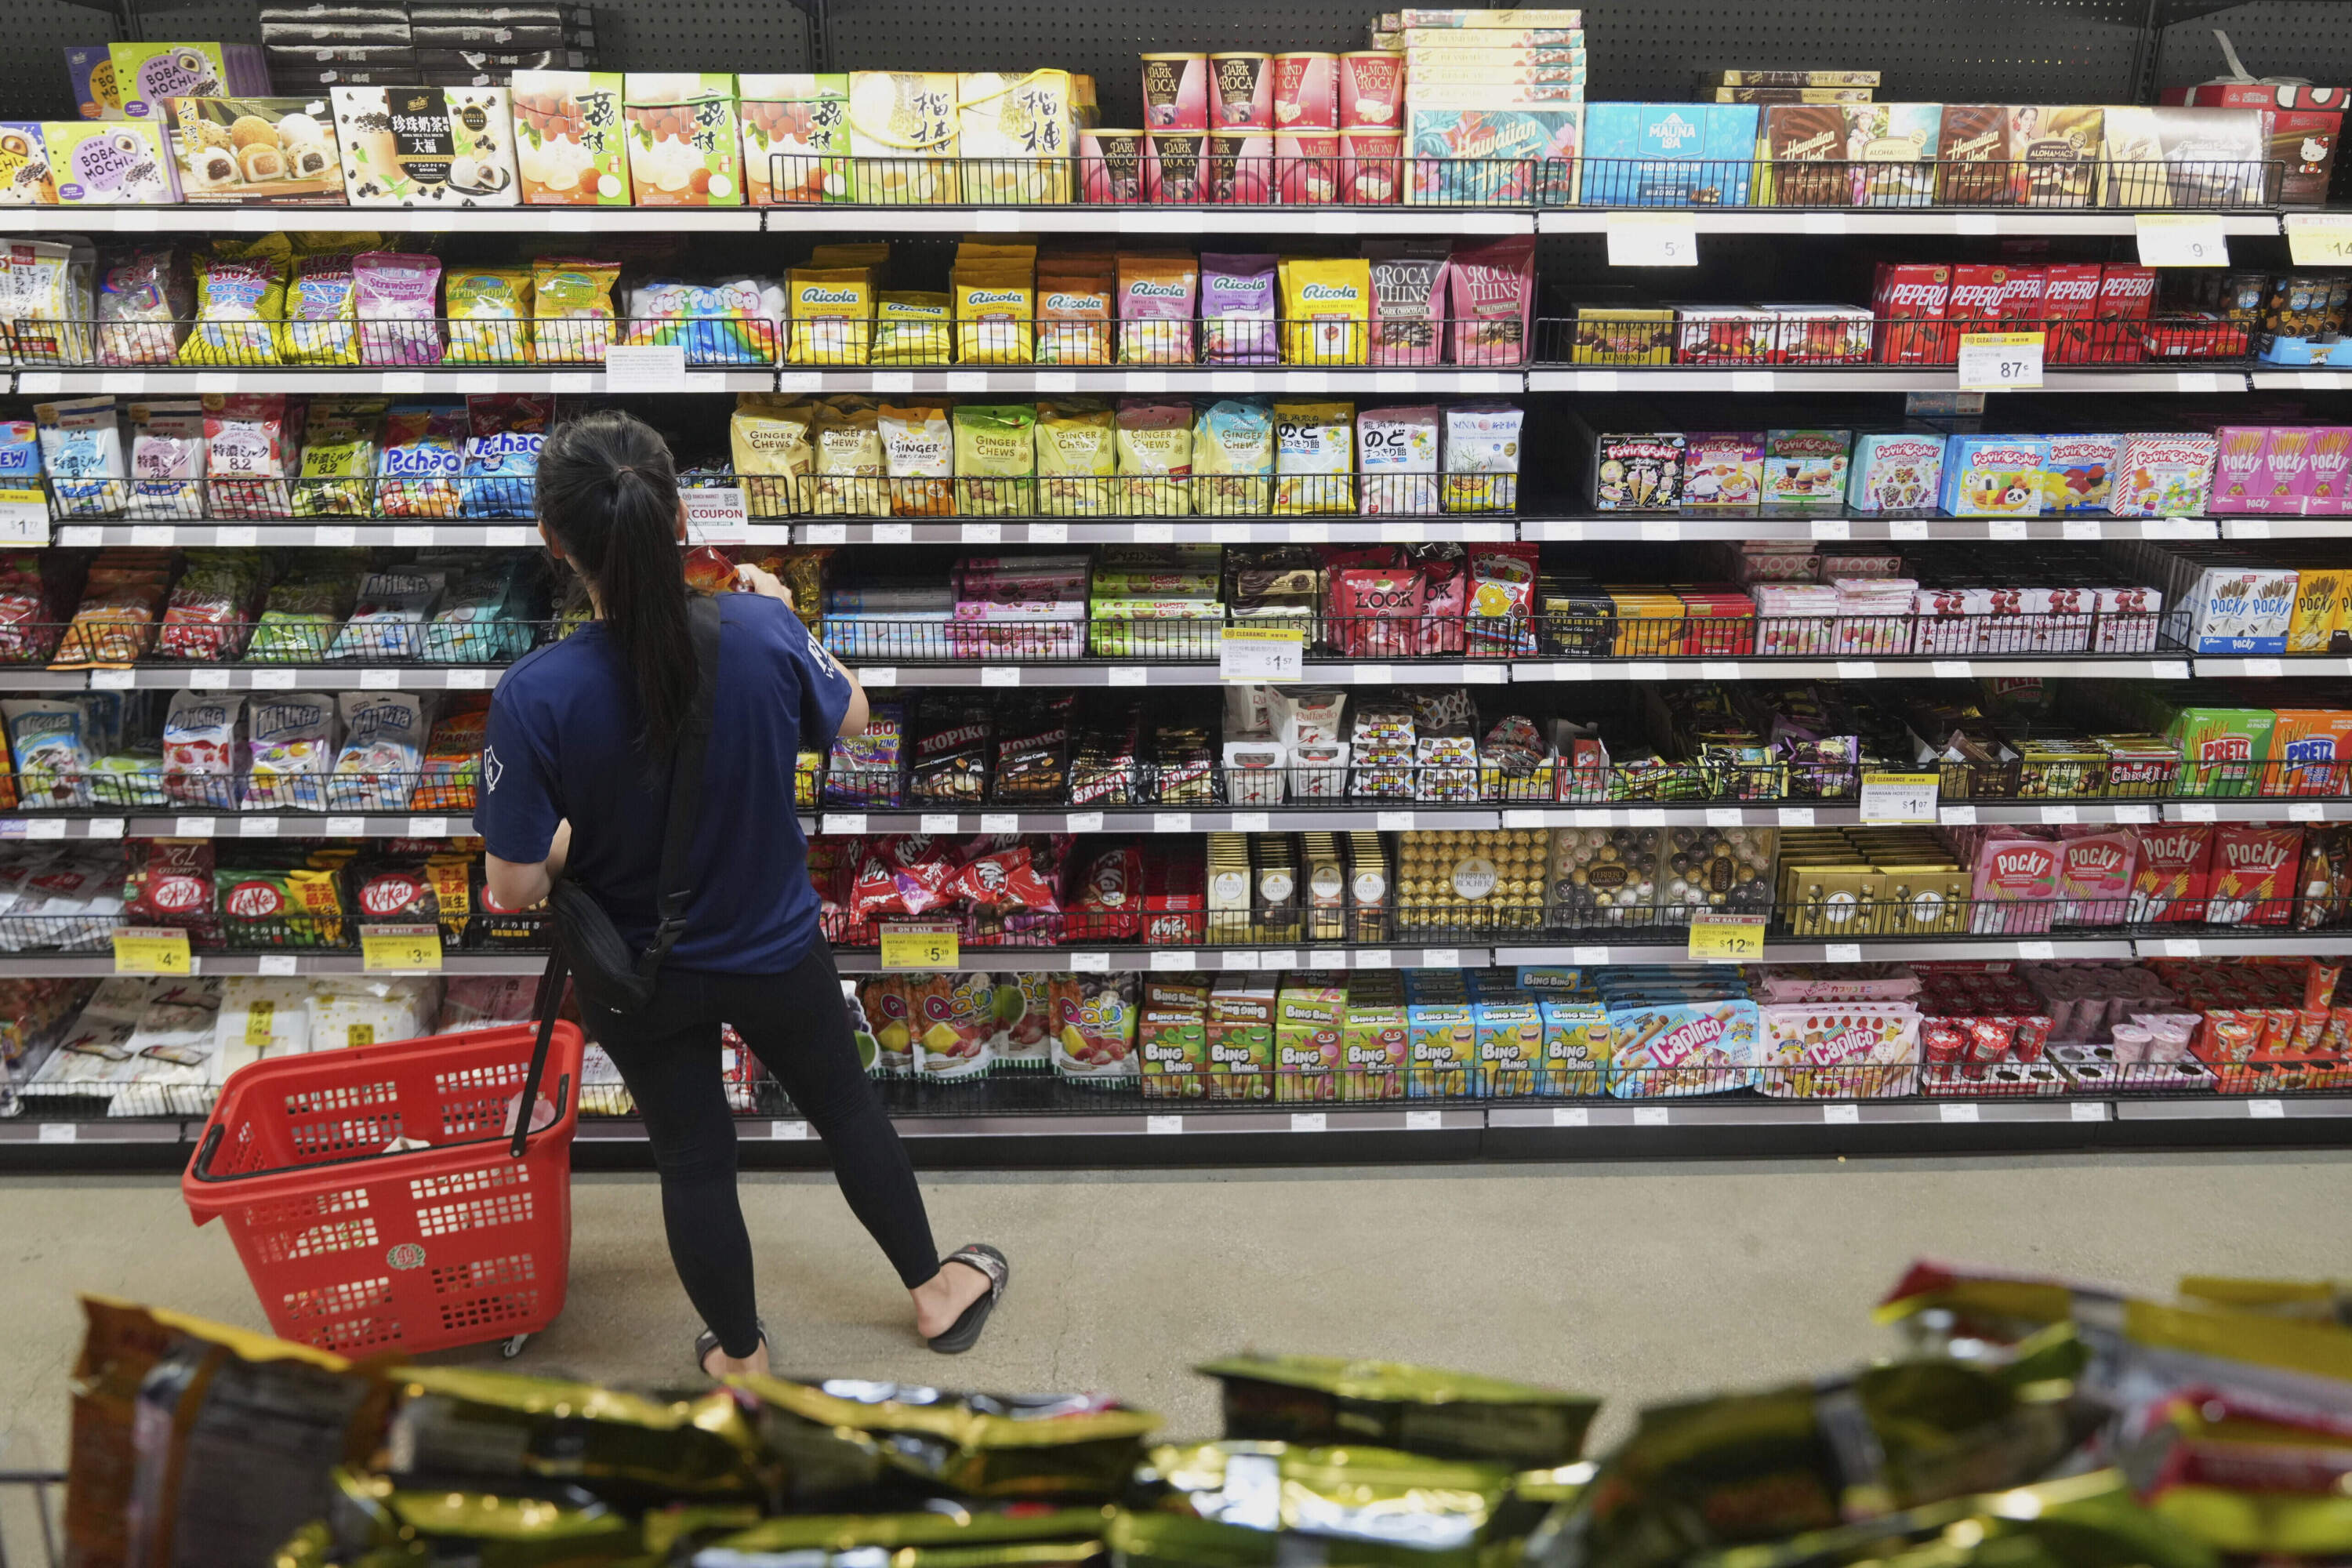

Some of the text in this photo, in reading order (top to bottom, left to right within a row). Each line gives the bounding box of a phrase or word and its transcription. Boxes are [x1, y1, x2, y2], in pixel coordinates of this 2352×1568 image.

[146, 66, 181, 86] BOBA
[1148, 66, 1172, 80] DARK
[1221, 64, 1250, 78] DARK
[1356, 64, 1396, 78] ALMOND
[1145, 77, 1177, 92] ROCA
[1219, 76, 1254, 91] ROCA
[1358, 76, 1393, 90] ROCA
[392, 115, 444, 133] 珍珠奶茶
[1649, 123, 1697, 138] MAUNA
[412, 138, 437, 154] 大福
[1109, 140, 1135, 153] DARK
[1356, 142, 1396, 156] ALMOND
[1455, 120, 1537, 168] Hawaiian
[1661, 136, 1682, 150] LOA
[1780, 129, 1836, 160] Hawaiian
[1945, 129, 1999, 160] Hawaiian
[81, 146, 117, 168] BOBA
[2030, 149, 2075, 158] ALOHAMACS
[1376, 264, 1430, 286] ROCA
[1468, 263, 1518, 285] ROCA
[206, 283, 265, 296] COTTON
[368, 278, 425, 292] Strawberry
[1130, 281, 1188, 299] Ricola
[1212, 276, 1267, 292] Ricola
[1301, 282, 1358, 300] Ricola
[1468, 281, 1521, 301] THINS
[2045, 280, 2100, 301] PEPERO
[2100, 278, 2155, 298] PEPERO
[800, 286, 859, 304] Ricola
[967, 289, 1025, 306] Ricola
[1046, 292, 1103, 310] Ricola
[1375, 284, 1431, 303] THINS
[1890, 283, 1948, 306] PEPERO
[1950, 285, 2004, 307] PEPERO
[886, 302, 942, 316] Ricola
[2049, 302, 2089, 312] original
[2105, 299, 2145, 309] original
[750, 430, 793, 440] GINGER
[1131, 430, 1172, 440] GINGER
[1222, 430, 1263, 441] GINGER
[1278, 422, 1319, 440] のど
[1364, 428, 1405, 448] のど
[752, 438, 792, 449] CHEWS
[975, 434, 1017, 448] GINGER
[1133, 439, 1171, 449] CHEWS
[1224, 439, 1260, 450] CHEWS
[977, 445, 1015, 457] CHEWS
[2221, 452, 2263, 474] POCKY
[2267, 452, 2309, 474] POCKY
[2245, 497, 2271, 510] POCKY
[691, 509, 743, 519] COUPON
[1354, 590, 1414, 609] LOOK
[2210, 596, 2249, 616] POCKY
[2252, 597, 2292, 616] POCKY
[2299, 594, 2336, 613] POCKY
[2232, 638, 2256, 650] POCKY
[1294, 709, 1338, 722] Raffaello
[923, 725, 990, 753] KOPIKO
[1000, 729, 1065, 754] KOPIKO
[2203, 740, 2249, 764] PRETZ
[2287, 741, 2333, 767] PRETZ
[2068, 844, 2120, 869] POCKY
[2141, 833, 2201, 863] POCKY
[2225, 840, 2288, 869] POCKY
[1998, 851, 2050, 876] POCKY
[1548, 1041, 1587, 1058] BING
[1653, 1019, 1722, 1065] Caplico
[1810, 1029, 1875, 1066] Caplico
[1145, 1044, 1183, 1061] BING
[1211, 1044, 1250, 1062] BING
[1281, 1047, 1320, 1064] BING
[1348, 1045, 1386, 1062] BING
[1414, 1043, 1452, 1060] BING
[1165, 1060, 1193, 1073] BING
[1231, 1060, 1260, 1073] BING
[1566, 1058, 1596, 1070] BING
